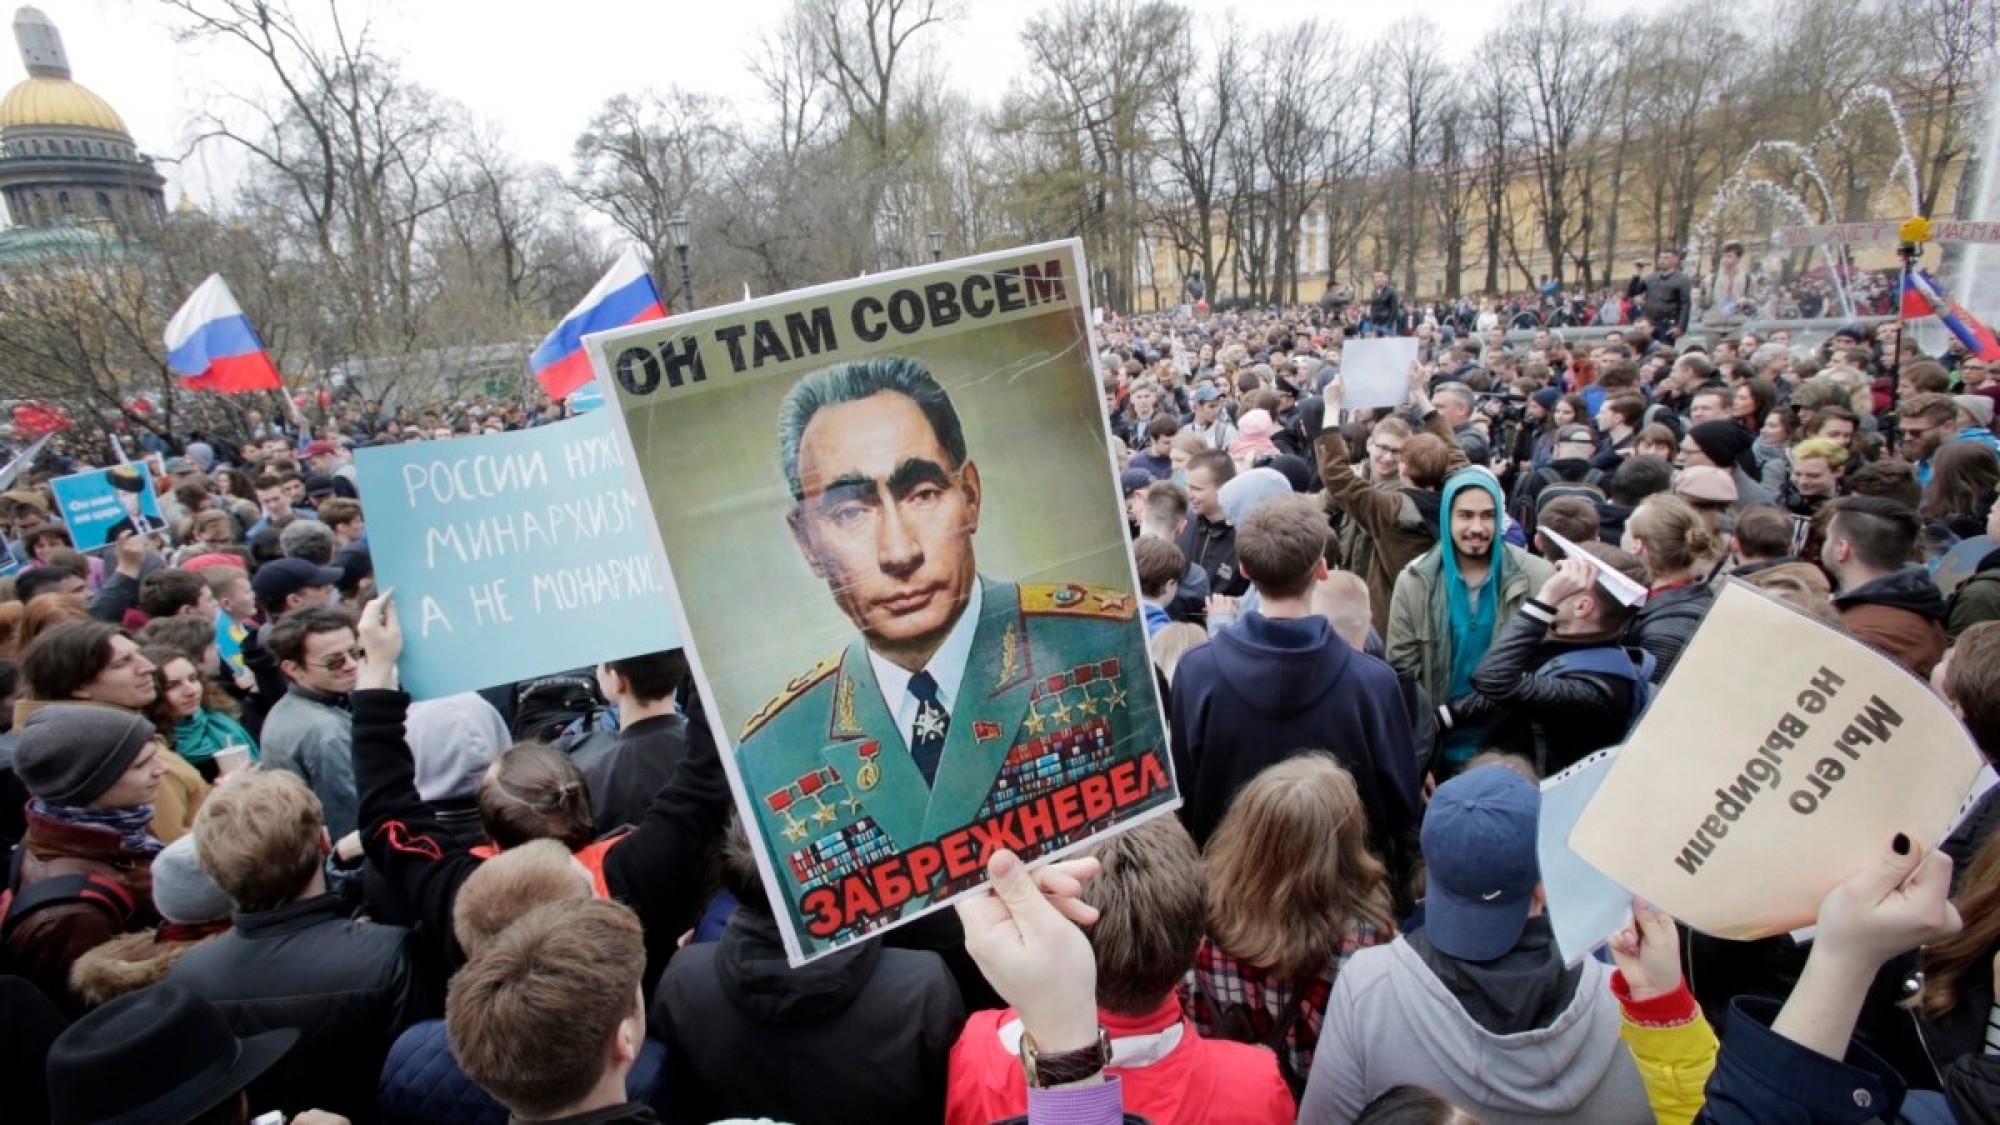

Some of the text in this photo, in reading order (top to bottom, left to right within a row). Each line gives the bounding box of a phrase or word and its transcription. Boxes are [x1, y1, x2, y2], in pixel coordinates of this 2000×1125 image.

[616, 259, 1067, 396] ОН ТАМ СОВСЕМ
[402, 429, 624, 507] РОССИИ НУЖ
[421, 551, 665, 637] А НЕ МОНАРХИ
[1675, 666, 1846, 876] не выбирали
[1788, 694, 1904, 815] Мы его
[803, 750, 1169, 938] ЗАБРЕЖНЕВЕЛ
